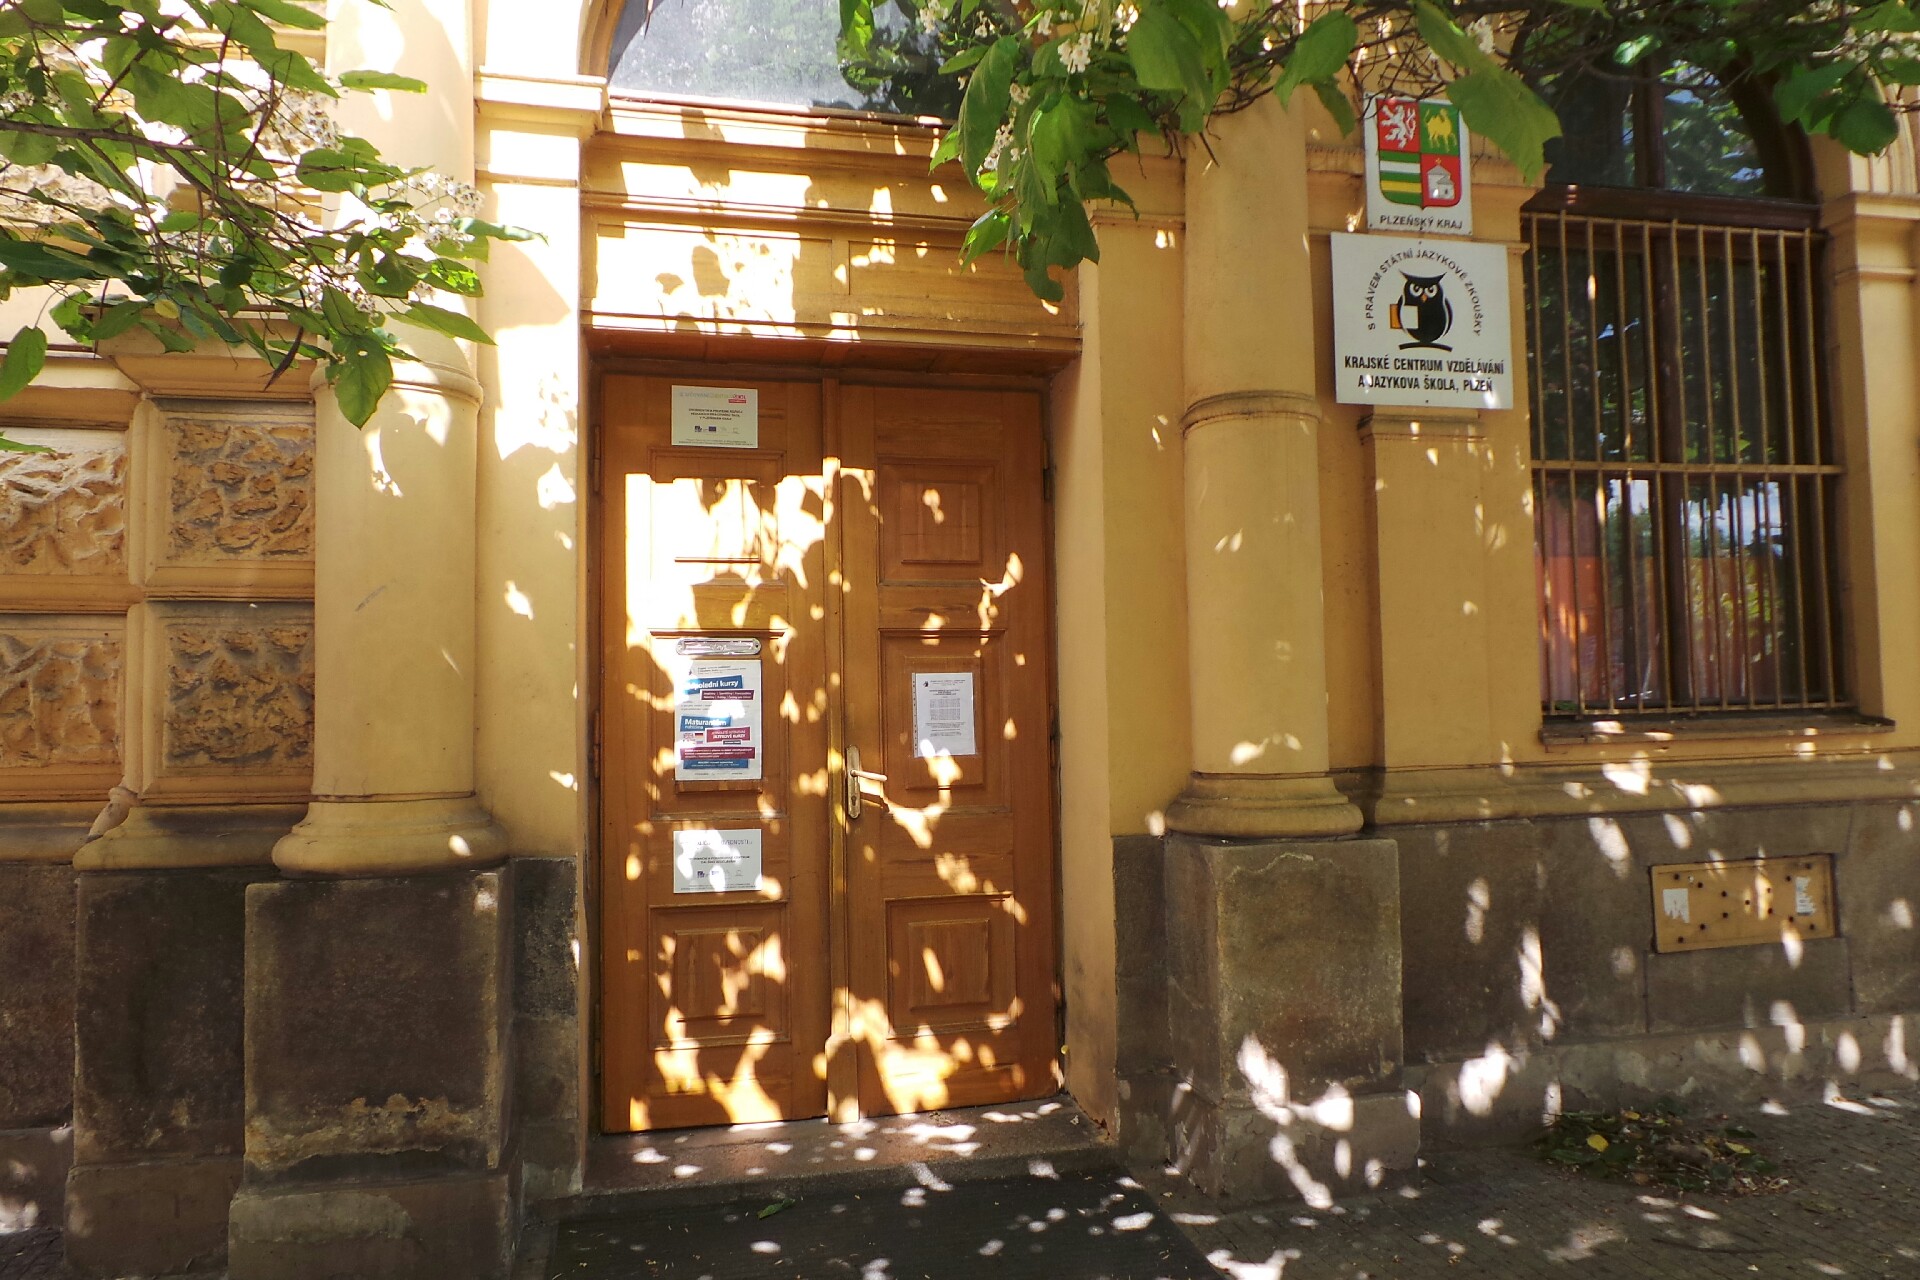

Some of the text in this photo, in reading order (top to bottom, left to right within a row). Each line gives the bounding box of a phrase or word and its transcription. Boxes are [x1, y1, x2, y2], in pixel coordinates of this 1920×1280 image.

[1437, 218, 1463, 229] KRAJ
[1364, 248, 1484, 337] S PRÁVEM STÁTNÍ JAZYKOVÉ ZKOUŠKY
[1344, 354, 1504, 375] KRAJSKÉ CENTRUM VZDĚLÁVÁNÍ
[1358, 375, 1365, 388] A
[1424, 375, 1459, 393] ŠKOLA,
[1463, 377, 1493, 392] PLZEŇ
[720, 680, 739, 688] kurzy
